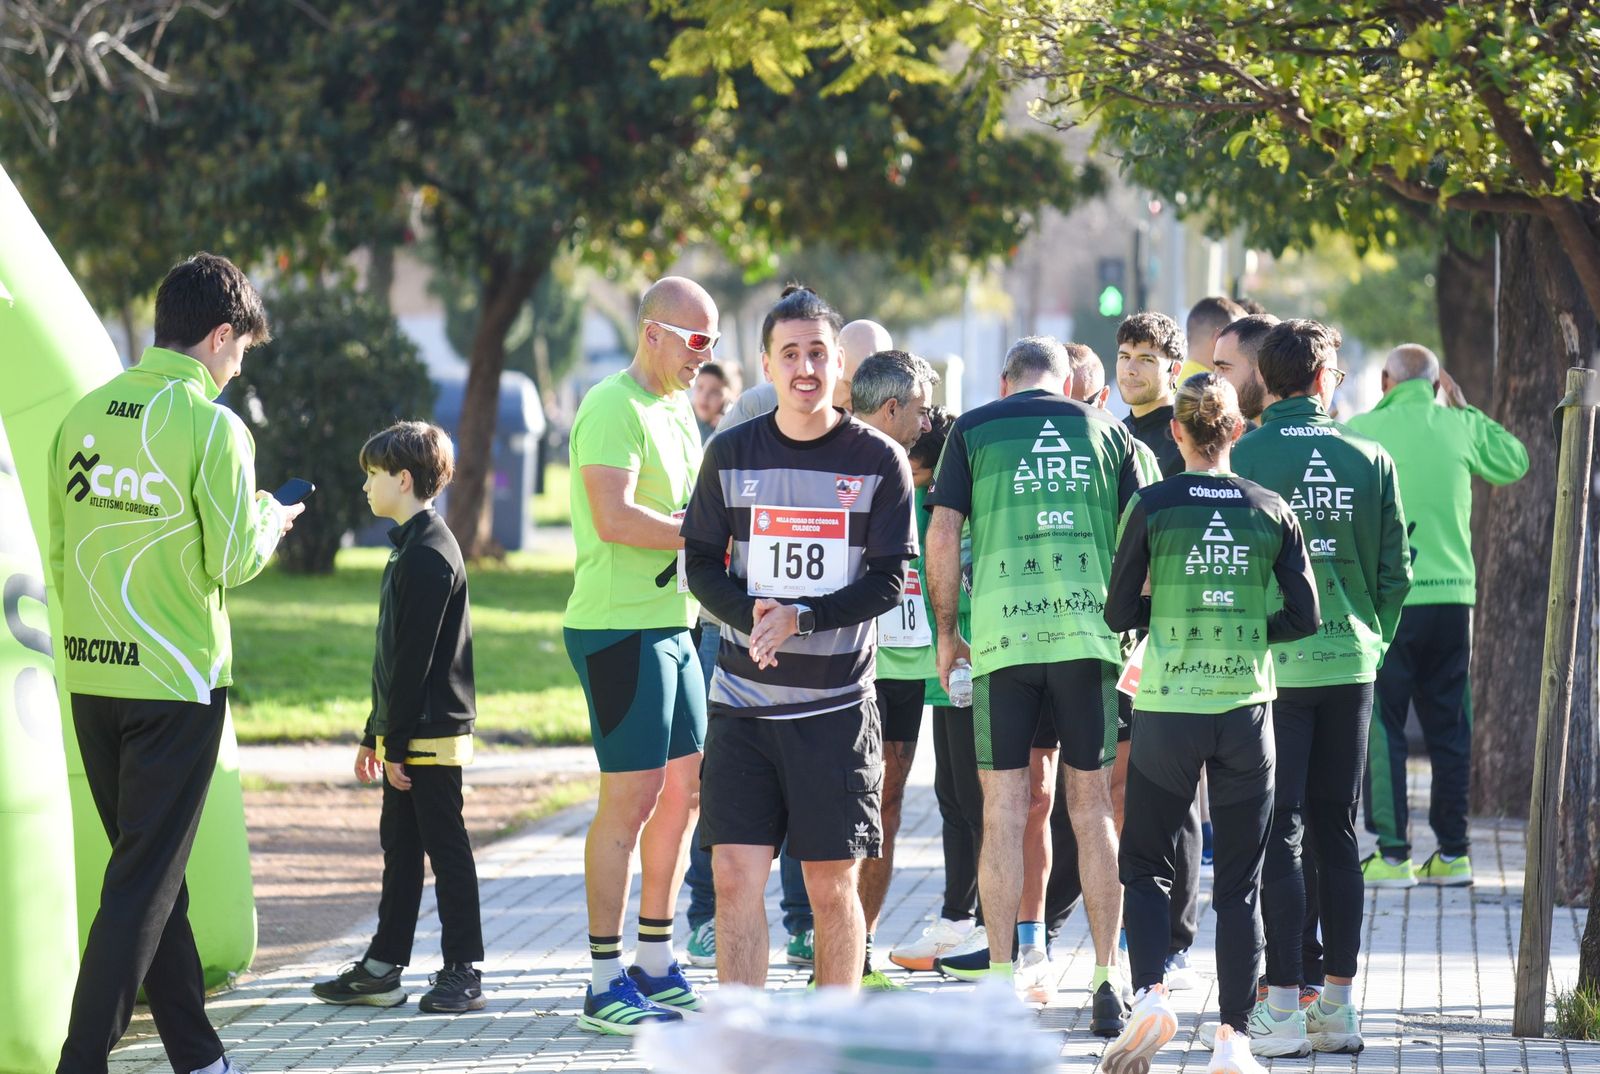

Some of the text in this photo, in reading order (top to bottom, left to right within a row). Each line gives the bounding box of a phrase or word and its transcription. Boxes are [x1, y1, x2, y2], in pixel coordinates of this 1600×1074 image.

[106, 400, 144, 419] DANI
[1280, 425, 1342, 437] CÓRDOBA
[1013, 456, 1091, 481] AIRE
[90, 464, 164, 505] CAC
[1013, 481, 1091, 494] SPORT
[1189, 485, 1243, 499] CÓRDOBA
[89, 496, 159, 517] ATLETISMO CORDOBÉS
[1289, 486, 1355, 510] AIRE
[1036, 510, 1075, 526] CAC
[1309, 538, 1336, 551] CAC
[769, 541, 825, 581] 158
[1185, 544, 1250, 565] AIRE
[1185, 565, 1249, 576] SPORT
[1202, 590, 1234, 602] CAC
[64, 635, 140, 667] PORCUNA
